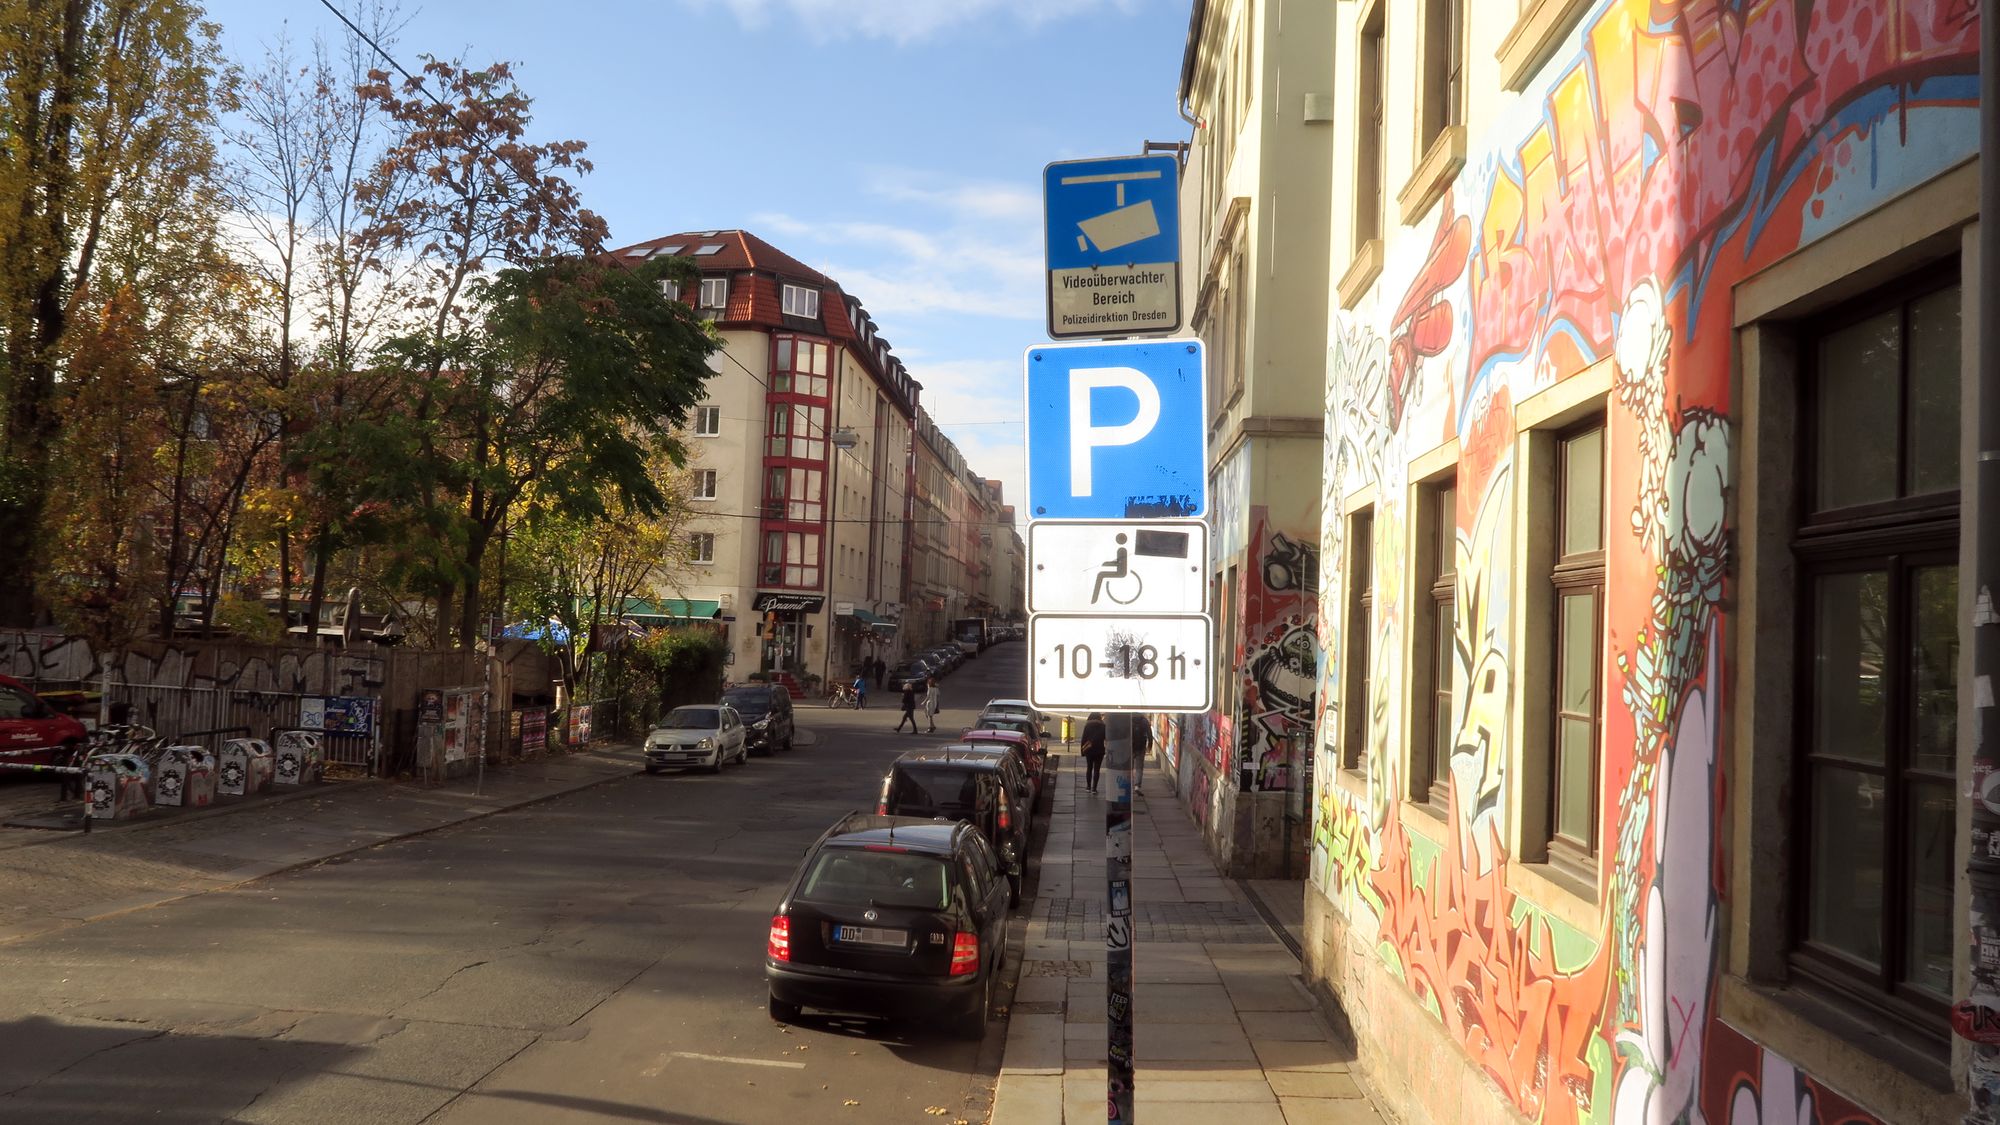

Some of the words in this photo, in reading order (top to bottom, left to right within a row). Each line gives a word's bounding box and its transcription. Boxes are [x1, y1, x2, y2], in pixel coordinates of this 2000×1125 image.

[1062, 272, 1165, 289] Videoüberwachter
[1093, 291, 1135, 306] Bereich
[1062, 313, 1129, 325] Polizeidirektion
[1132, 310, 1167, 321] Dresden
[1069, 366, 1161, 497] P
[1170, 645, 1186, 681] h
